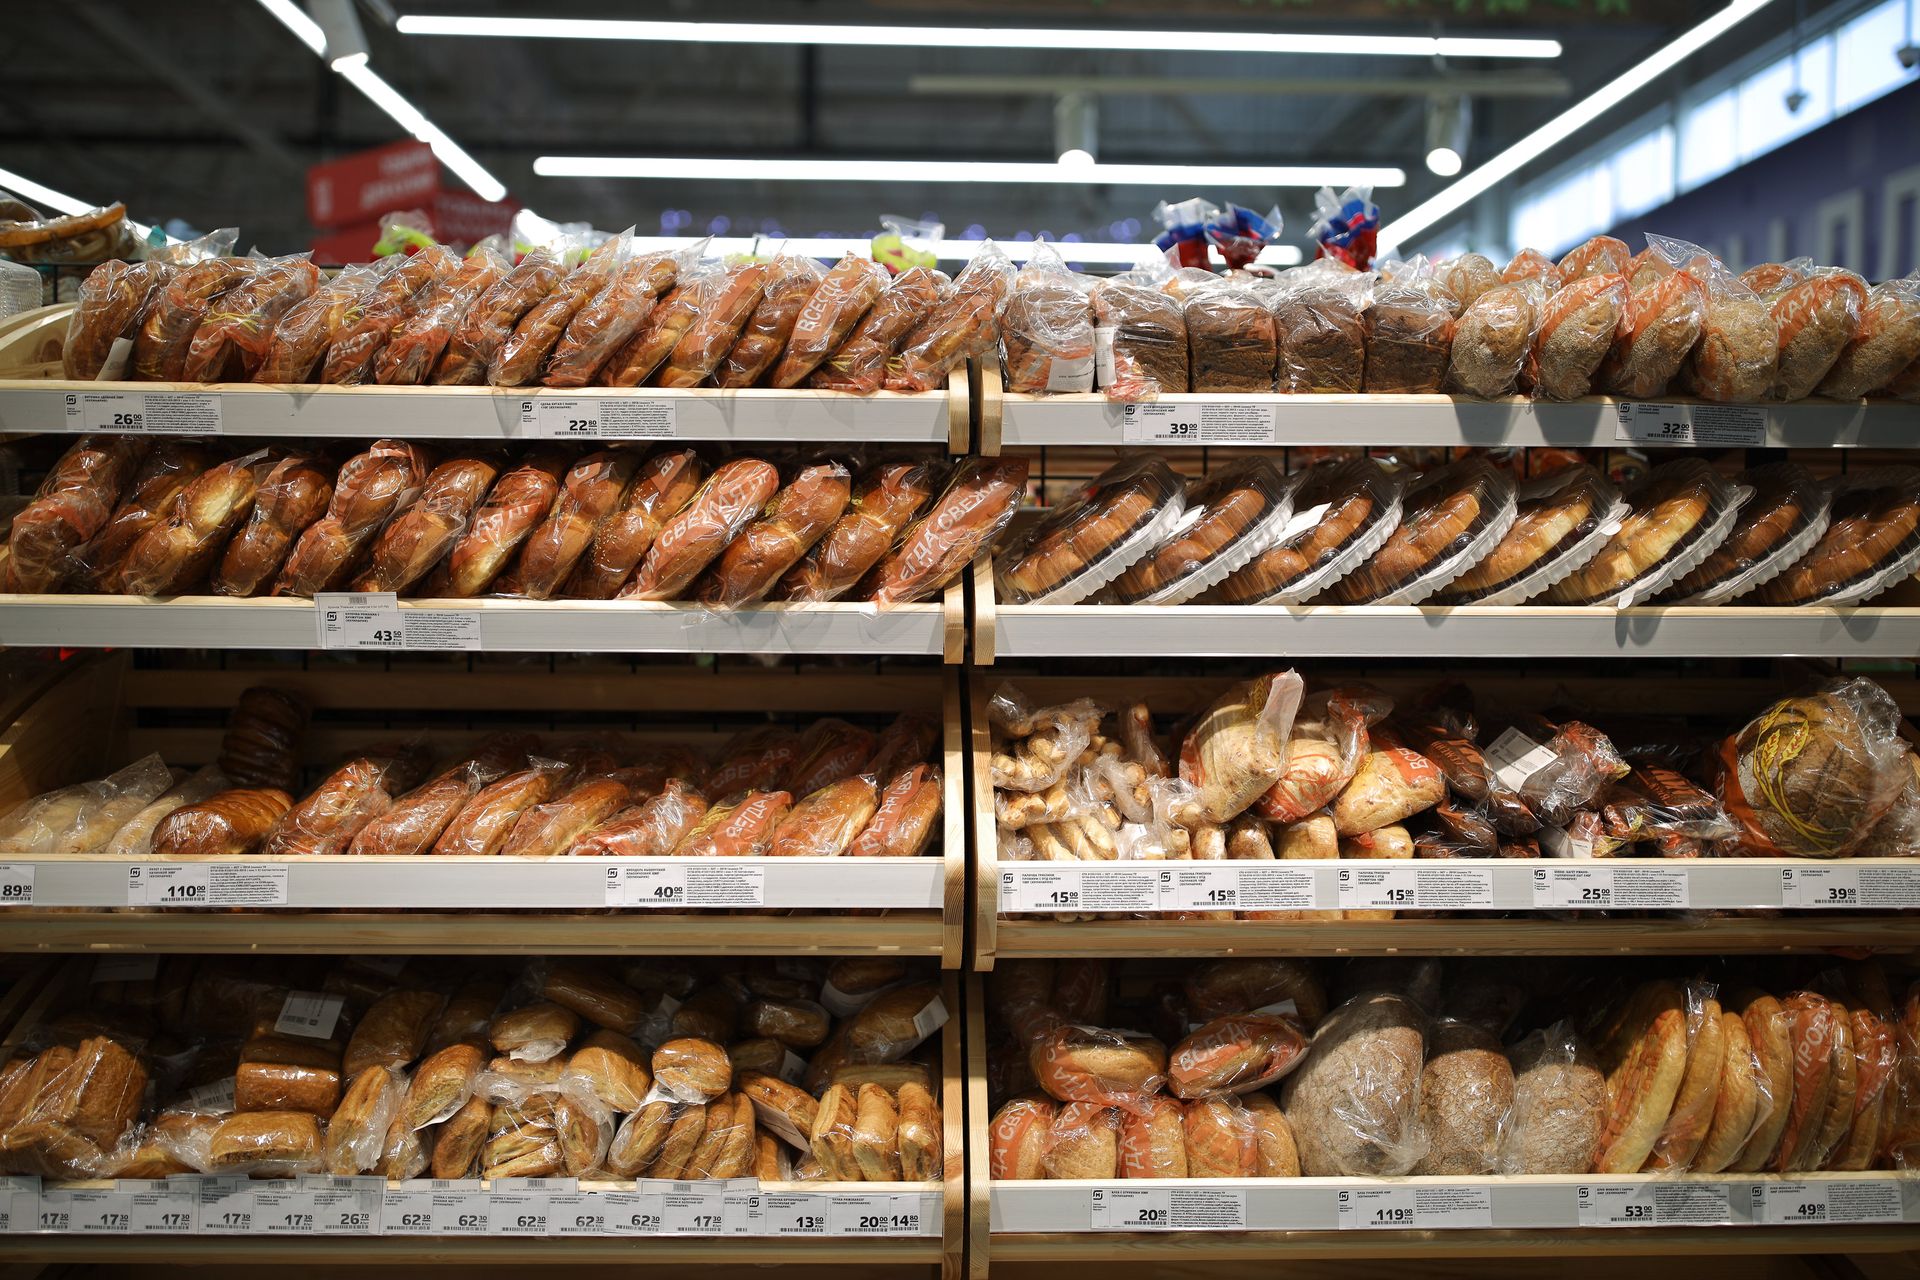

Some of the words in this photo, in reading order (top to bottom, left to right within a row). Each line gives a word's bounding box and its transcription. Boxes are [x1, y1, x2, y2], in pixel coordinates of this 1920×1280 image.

[798, 275, 846, 333] ВСЕГДА
[114, 414, 133, 424] 26
[570, 420, 587, 430] 22
[1170, 424, 1188, 434] 39
[1662, 423, 1680, 434] 32
[374, 630, 392, 641] 43
[710, 748, 790, 789] СВЕАЯ
[3, 885, 22, 896] 89
[168, 886, 196, 896] 110
[654, 886, 673, 897] 40
[1208, 890, 1226, 900] 15
[1387, 890, 1404, 900] 15
[1583, 889, 1600, 899] 25
[1829, 888, 1847, 899] 39
[1051, 892, 1068, 902] 15
[1139, 1210, 1158, 1220] 20
[1377, 1209, 1404, 1220] 119
[1625, 1206, 1644, 1217] 53
[1798, 1204, 1816, 1215] 49
[41, 1213, 59, 1224] 17
[101, 1214, 119, 1225] 17
[162, 1214, 180, 1225] 17
[223, 1213, 241, 1224] 17
[285, 1215, 303, 1226] 17
[340, 1214, 360, 1224] 26
[402, 1214, 421, 1226] 62
[459, 1215, 477, 1226] 62
[518, 1216, 536, 1227] 62
[576, 1216, 594, 1227] 62
[632, 1215, 650, 1226] 62
[694, 1216, 712, 1227] 17
[796, 1217, 814, 1228] 13
[860, 1217, 879, 1228] 20
[891, 1215, 909, 1226] 14
